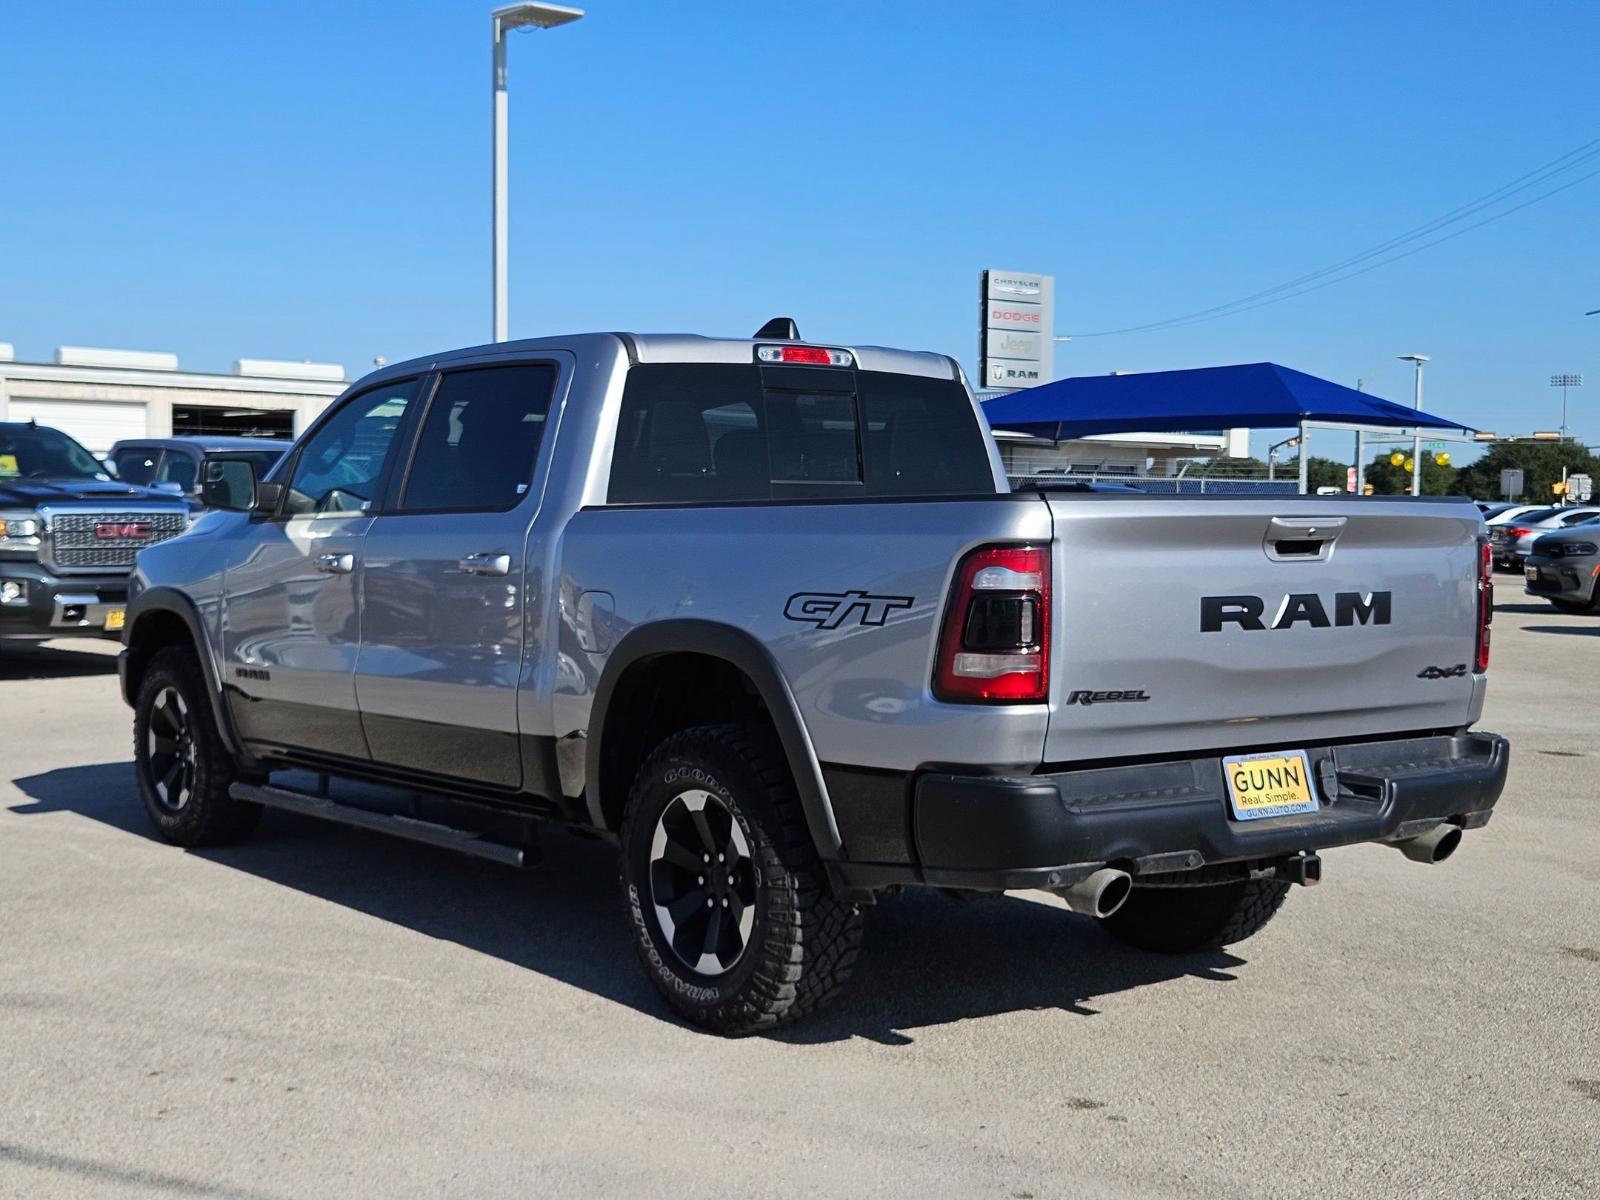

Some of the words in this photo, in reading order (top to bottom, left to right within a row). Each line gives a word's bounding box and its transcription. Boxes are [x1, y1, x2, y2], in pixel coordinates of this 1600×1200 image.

[994, 278, 1039, 288] CHRYSLER
[992, 311, 1040, 322] DODGE
[1001, 335, 1032, 354] Jeep
[1007, 369, 1038, 379] RAM
[96, 523, 151, 539] GMC
[1200, 591, 1392, 632] RAM
[236, 667, 270, 681] RAM
[1234, 766, 1300, 792] GUNN
[1241, 796, 1264, 806] Real.
[1265, 791, 1300, 803] Simple.
[1247, 803, 1309, 817] GUNNAUTO.COM
